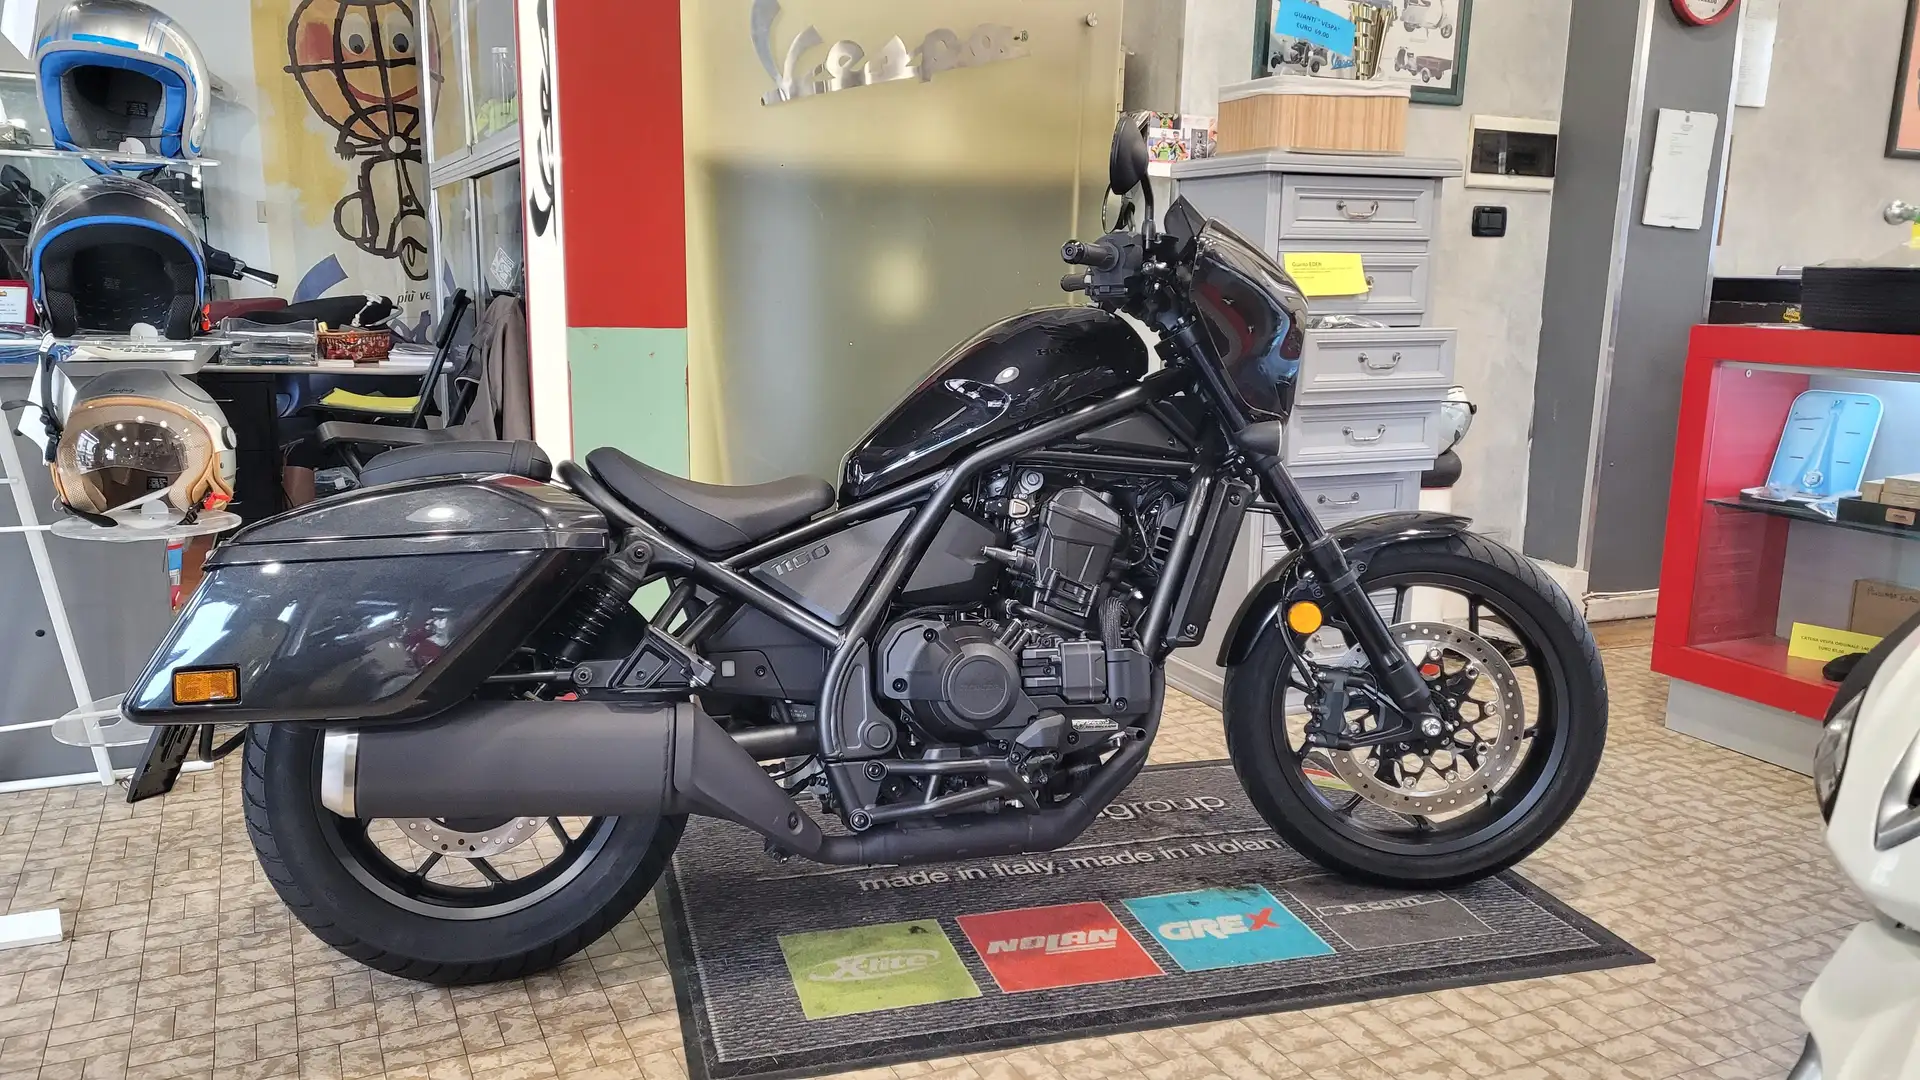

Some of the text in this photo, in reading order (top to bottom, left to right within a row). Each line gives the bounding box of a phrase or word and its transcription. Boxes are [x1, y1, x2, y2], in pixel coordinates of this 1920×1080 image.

[1293, 11, 1317, 23] GUANTI
[1296, 23, 1312, 32] EURO
[770, 543, 831, 576] 1100
[1096, 796, 1226, 820] group
[858, 870, 950, 891] made
[957, 866, 987, 881] in
[1070, 849, 1155, 870] made
[1159, 846, 1190, 861] in
[1158, 907, 1280, 940] GREX
[986, 928, 1118, 955] NOLAN
